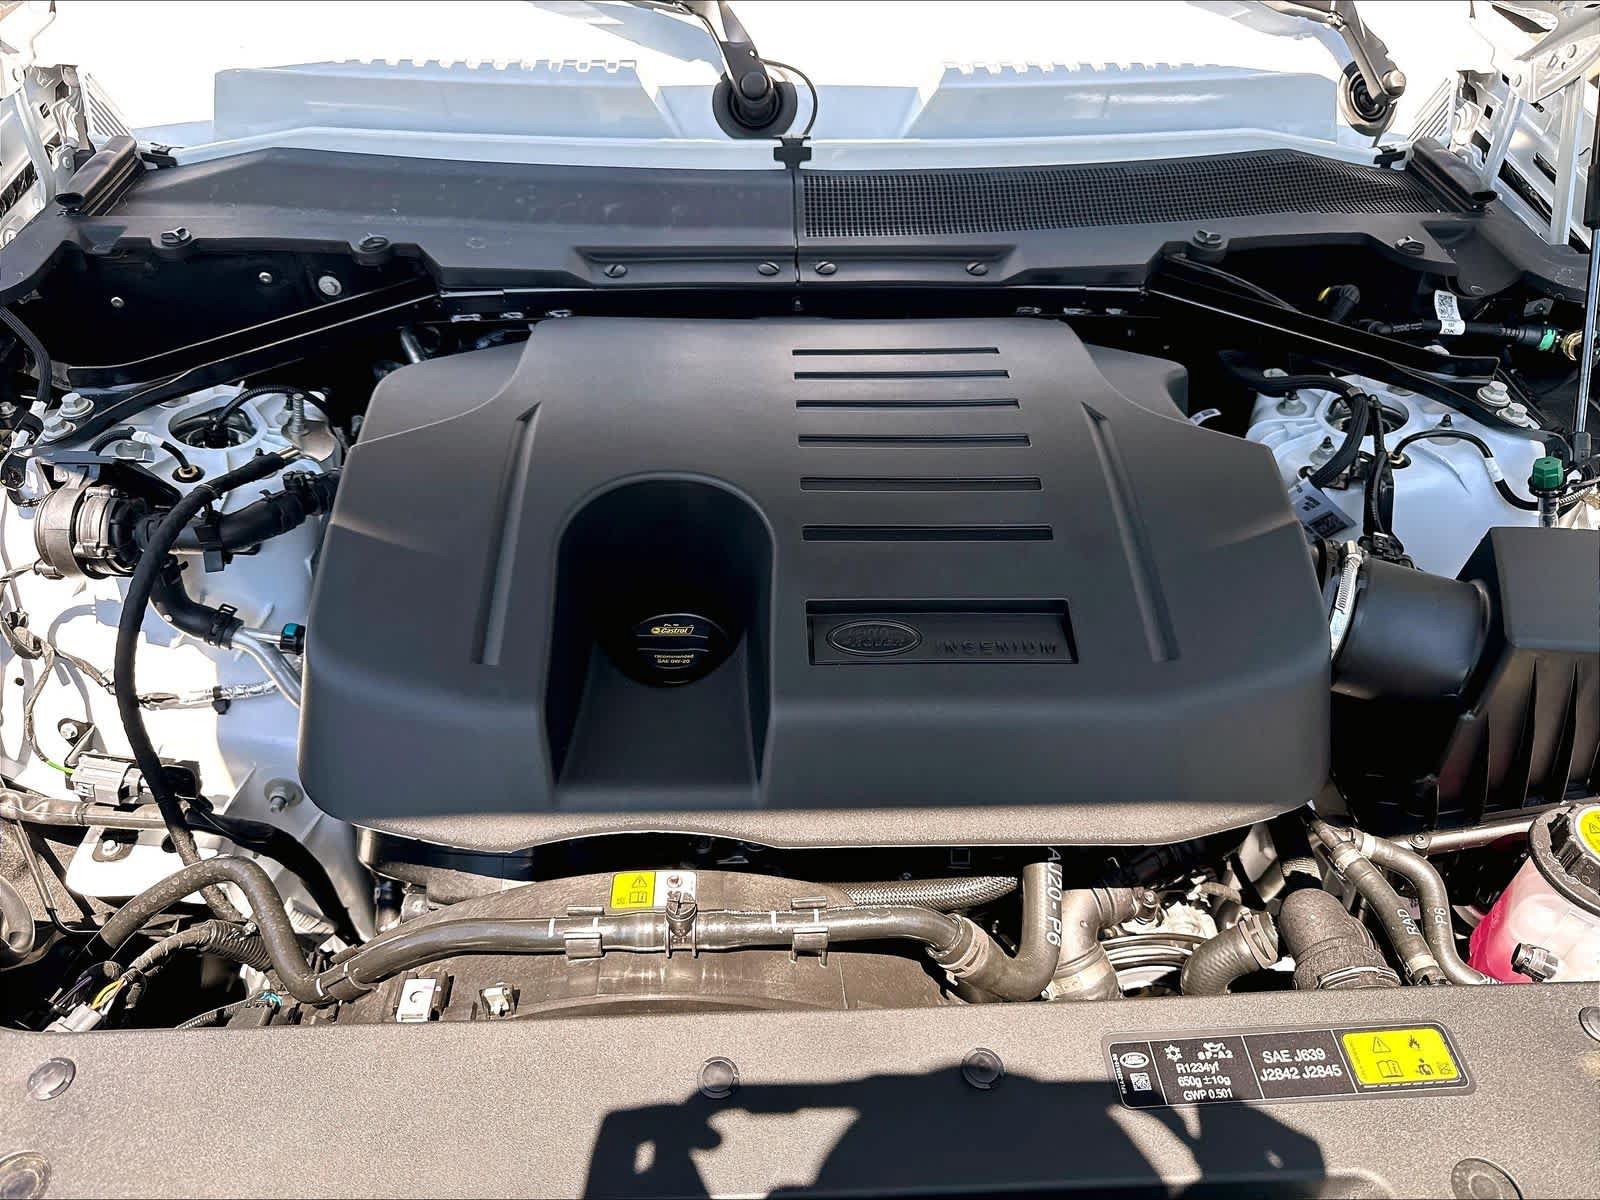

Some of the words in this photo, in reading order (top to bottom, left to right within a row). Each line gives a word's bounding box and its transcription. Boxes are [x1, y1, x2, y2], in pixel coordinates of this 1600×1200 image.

[1397, 908, 1421, 935] RAD
[1262, 1050, 1292, 1064] SAE
[1294, 1048, 1326, 1062] J639
[1176, 1063, 1220, 1074] R1234yf
[1260, 1066, 1300, 1082] J2842
[1302, 1064, 1342, 1079] J2845
[1177, 1075, 1202, 1087] 650g
[1183, 1089, 1206, 1101] GWP
[1208, 1088, 1233, 1100] 0.501
